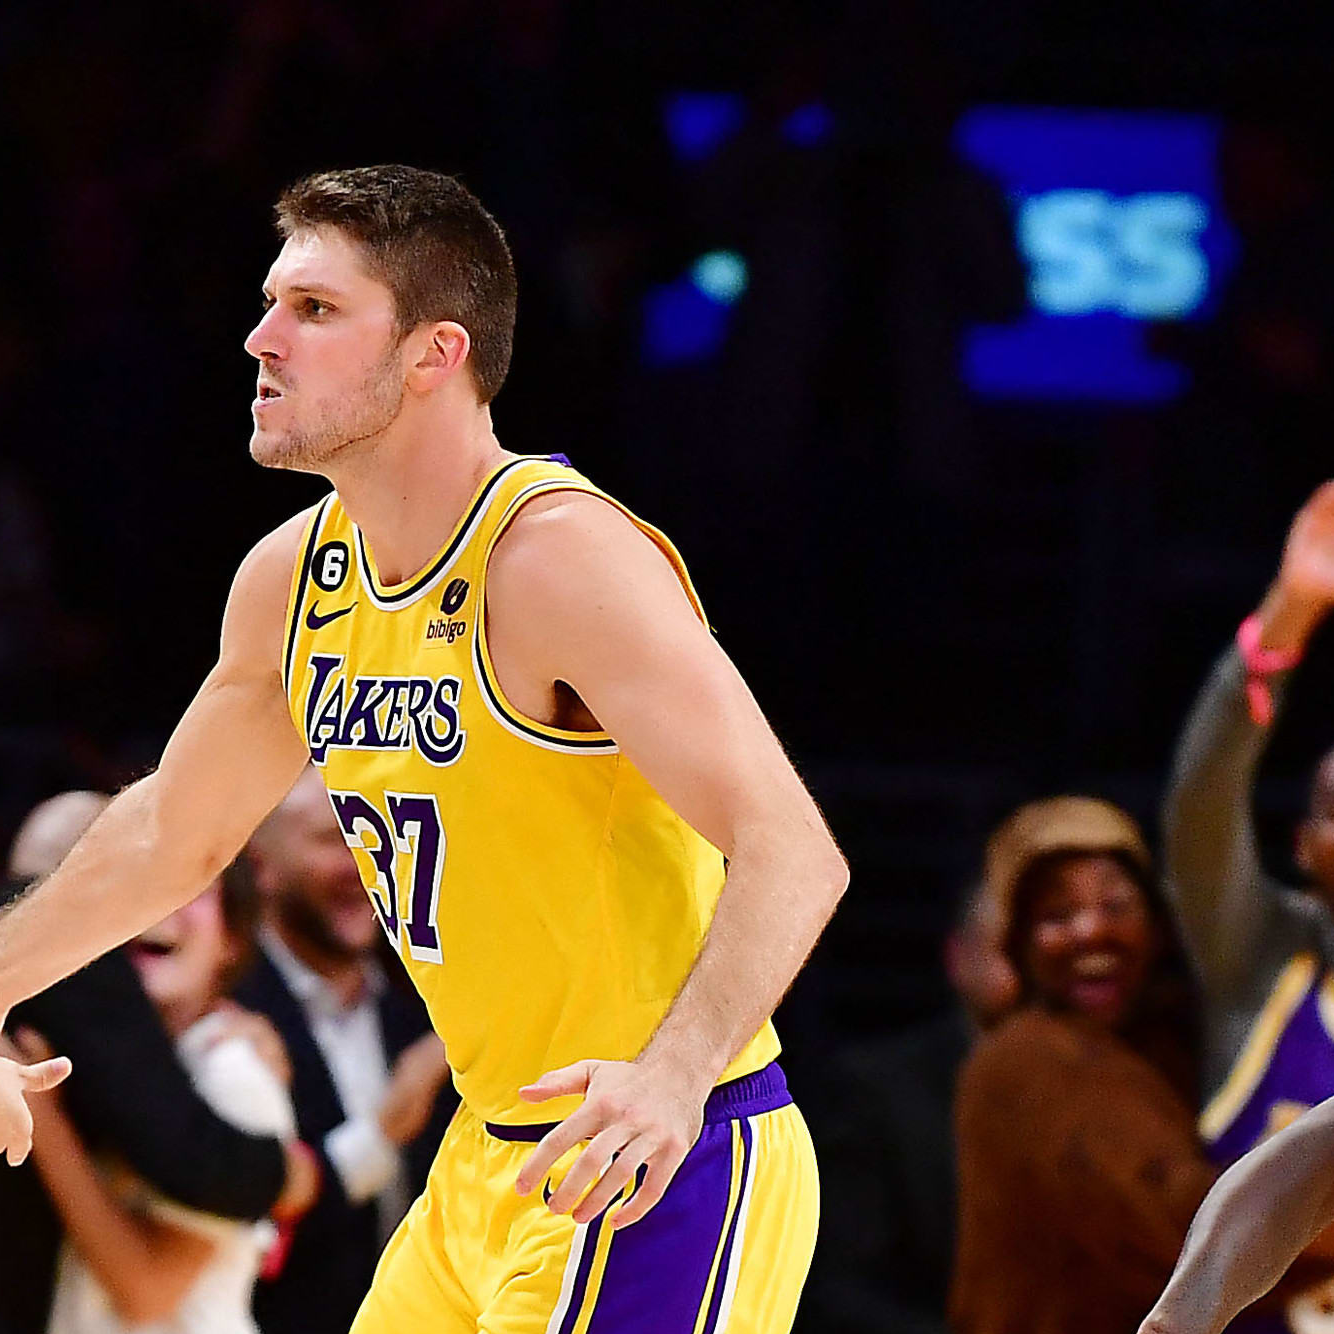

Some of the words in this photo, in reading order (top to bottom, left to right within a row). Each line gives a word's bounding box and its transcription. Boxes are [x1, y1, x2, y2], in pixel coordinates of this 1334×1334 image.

[321, 549, 345, 586] 6
[426, 618, 467, 644] bibigo
[307, 653, 466, 767] LAKERS
[329, 790, 446, 964] 37
